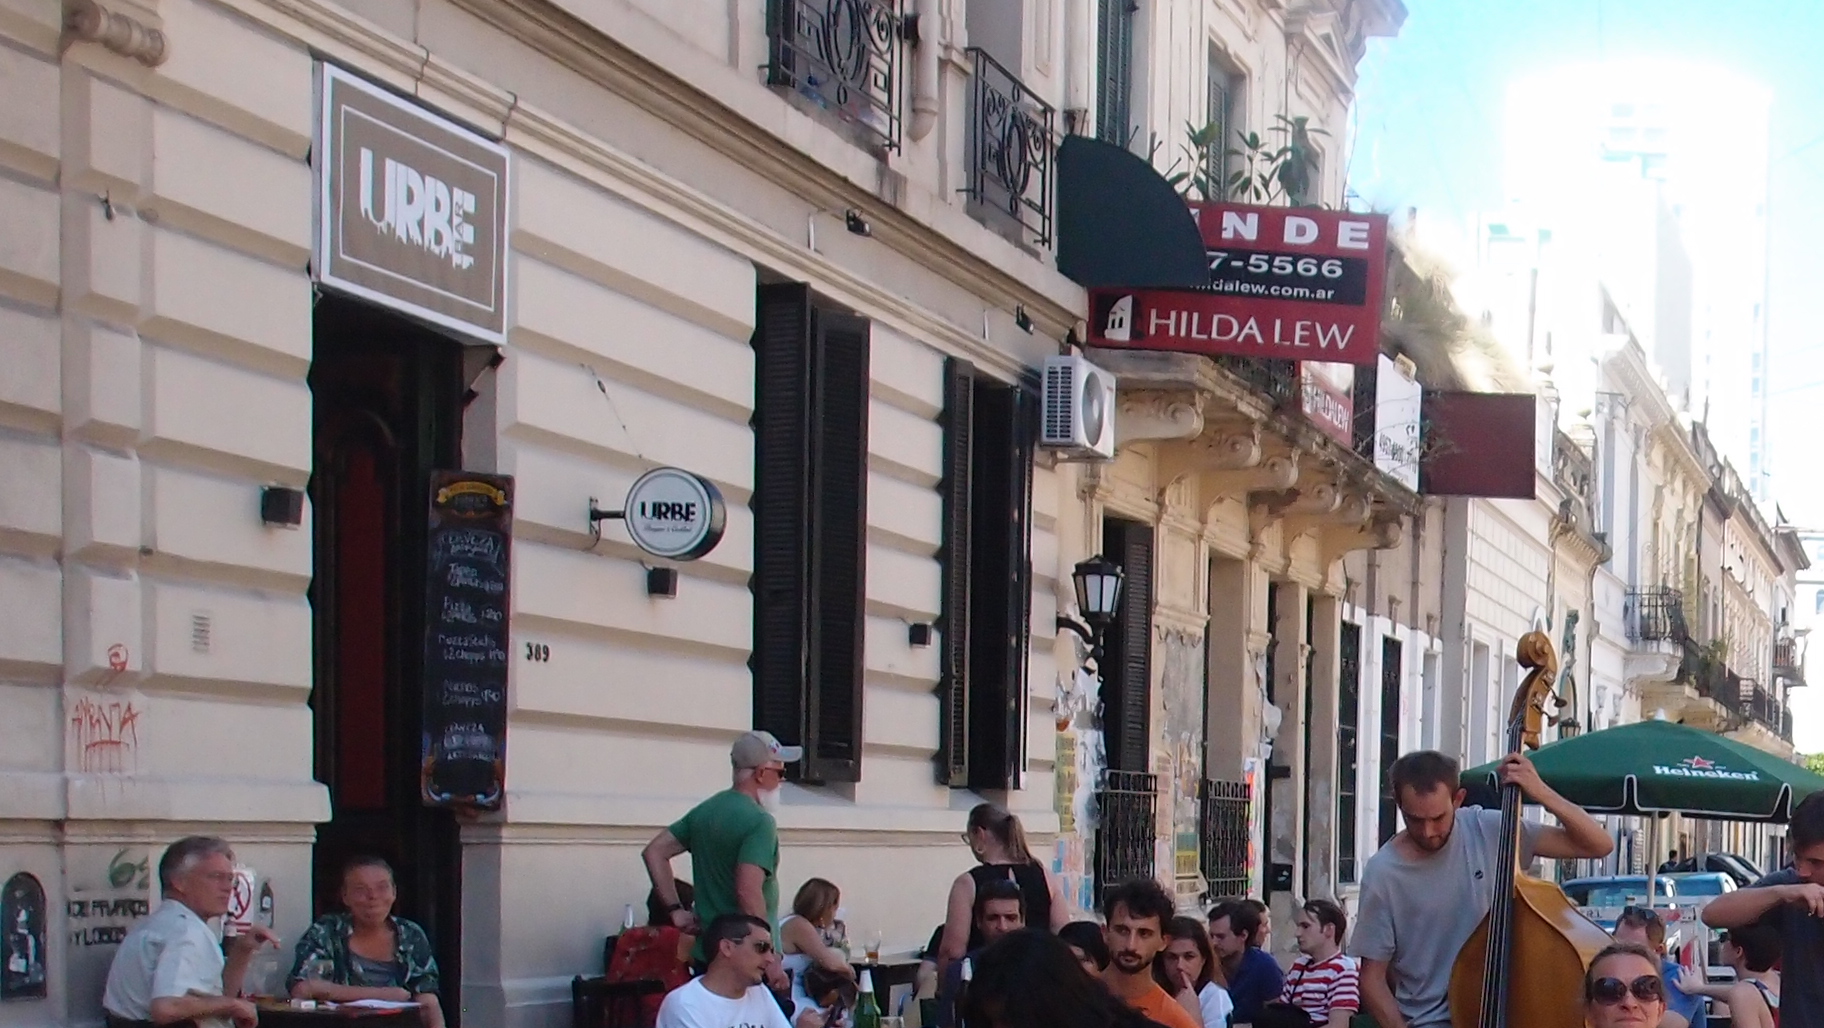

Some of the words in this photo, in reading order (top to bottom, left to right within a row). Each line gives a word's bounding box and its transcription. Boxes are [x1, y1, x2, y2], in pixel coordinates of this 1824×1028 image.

[360, 146, 475, 270] URBE
[1188, 207, 1370, 249] NDE
[1206, 250, 1344, 279] 7-5566
[1149, 308, 1264, 344] HILDA
[1273, 318, 1355, 350] LEW
[640, 501, 696, 522] URBE
[526, 641, 550, 663] 389
[1652, 765, 1760, 781] Heineken
